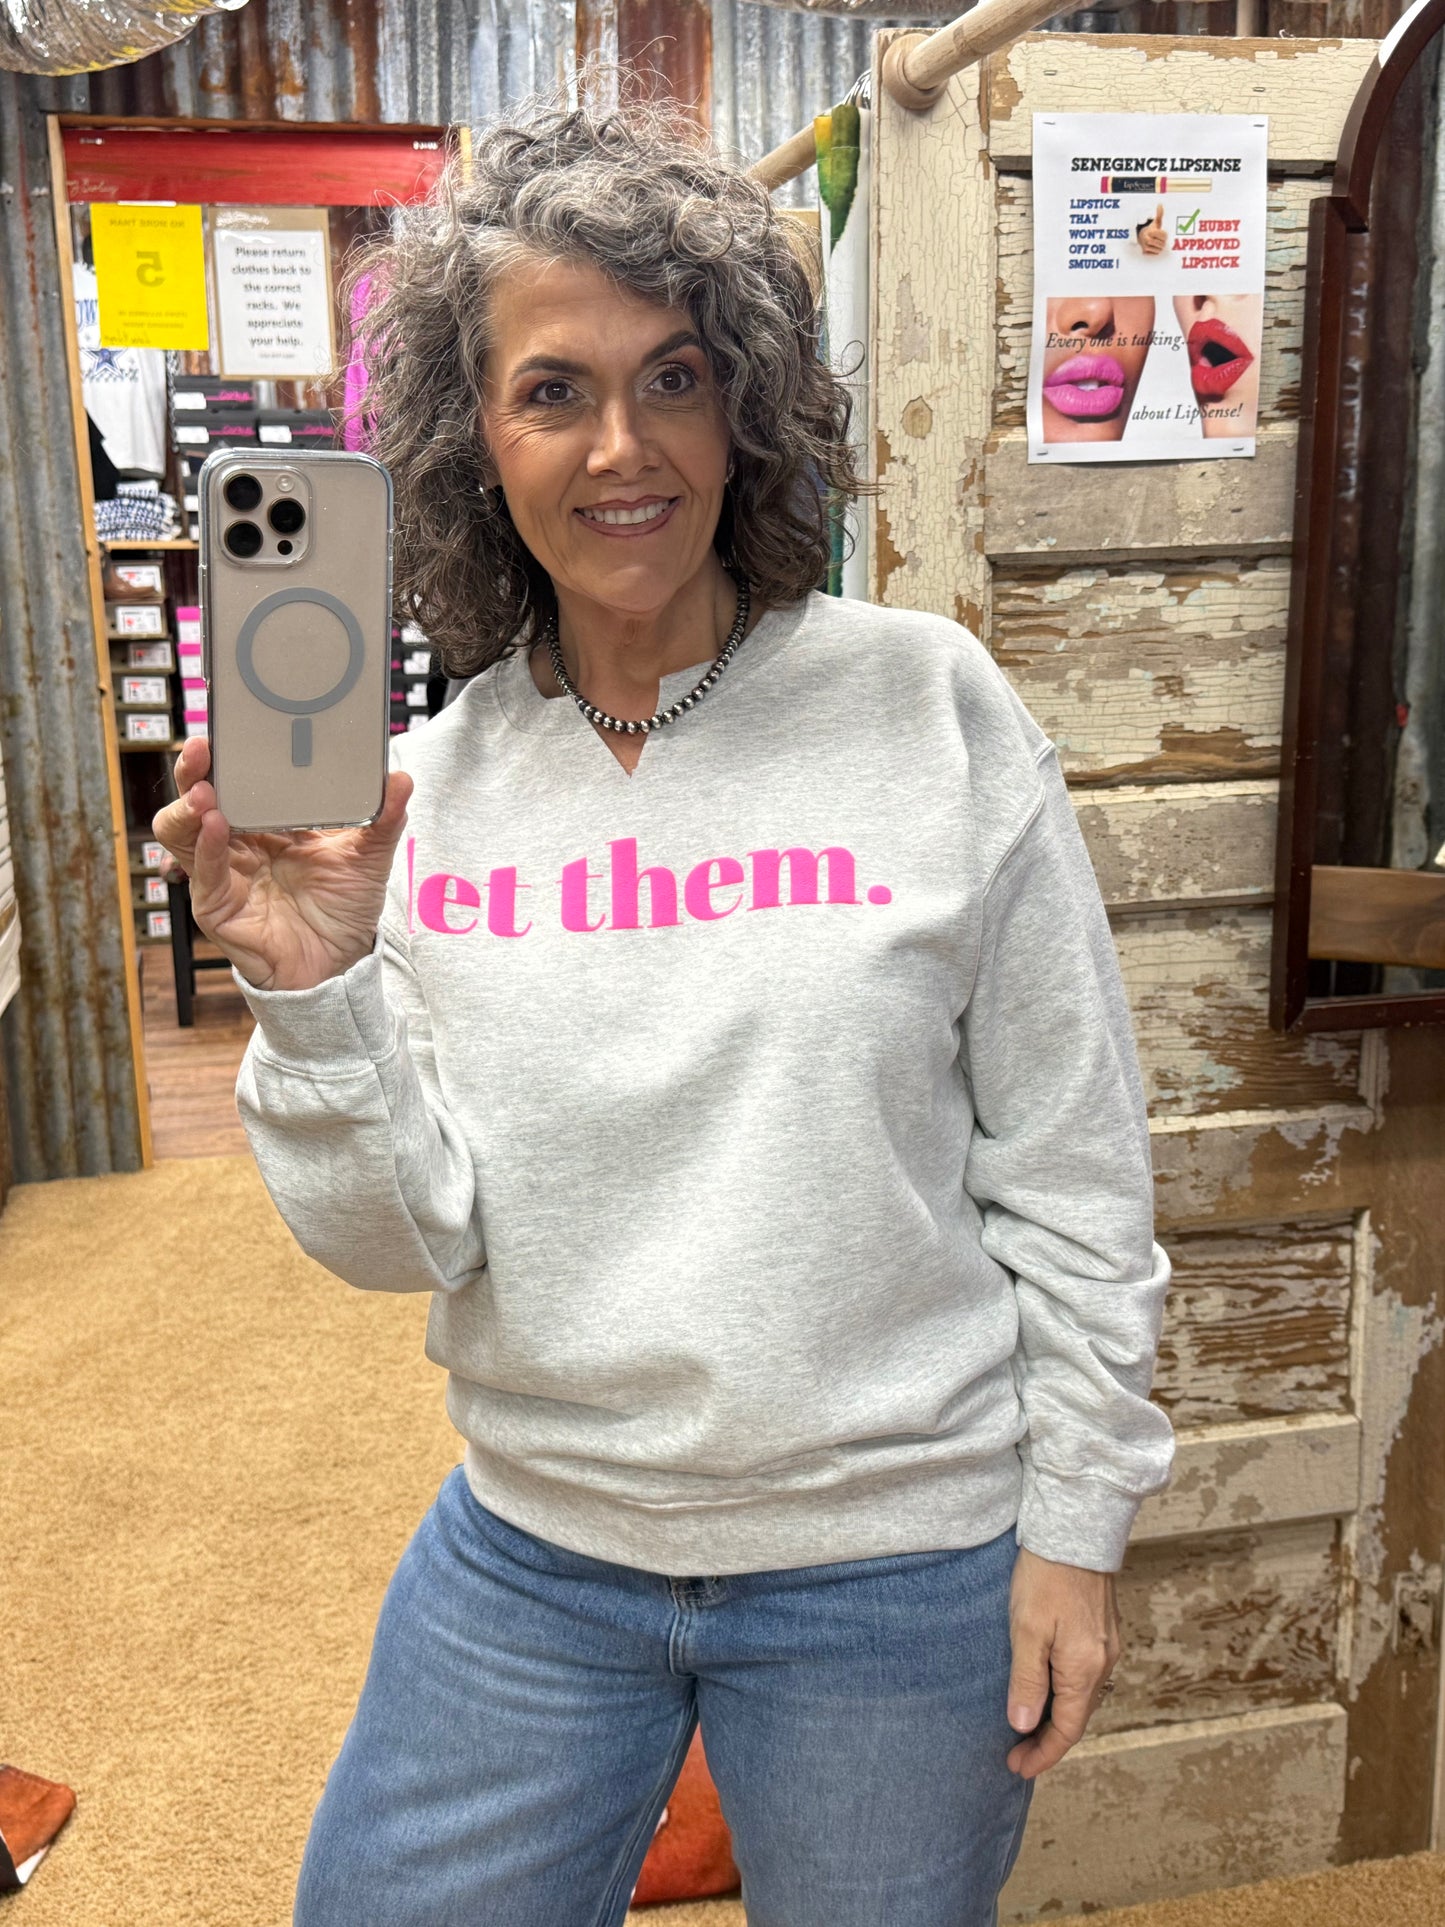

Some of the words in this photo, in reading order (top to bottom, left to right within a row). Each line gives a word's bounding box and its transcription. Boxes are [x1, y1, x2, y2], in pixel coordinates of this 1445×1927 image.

[1071, 157, 1167, 172] SENEGENCE
[1169, 157, 1242, 173] LIPSENSE
[1069, 198, 1121, 210] LIPSTICK
[1069, 213, 1099, 225] THAT
[1198, 219, 1241, 233] HUBBY
[1068, 228, 1105, 240] WON'T
[1106, 228, 1130, 240] KISS
[1068, 243, 1090, 255] OFF
[1090, 243, 1107, 255] OR
[1171, 237, 1241, 252] APPROVED
[234, 246, 269, 258] Please
[271, 247, 306, 258] return
[1181, 255, 1241, 270] LIPSTICK
[231, 264, 270, 276] clothes
[272, 264, 297, 276] back
[298, 265, 312, 276] to
[243, 282, 262, 293] the
[263, 283, 302, 293] correct
[245, 300, 278, 311] racks.
[281, 300, 301, 311] We
[247, 318, 304, 330] appreciate
[249, 337, 274, 348] your
[275, 336, 304, 348] help.
[1046, 333, 1087, 353] Every
[1089, 335, 1113, 348] one
[1116, 332, 1128, 347] is
[1131, 405, 1171, 421] about
[1174, 402, 1244, 425] LipSense!
[555, 837, 893, 933] them.
